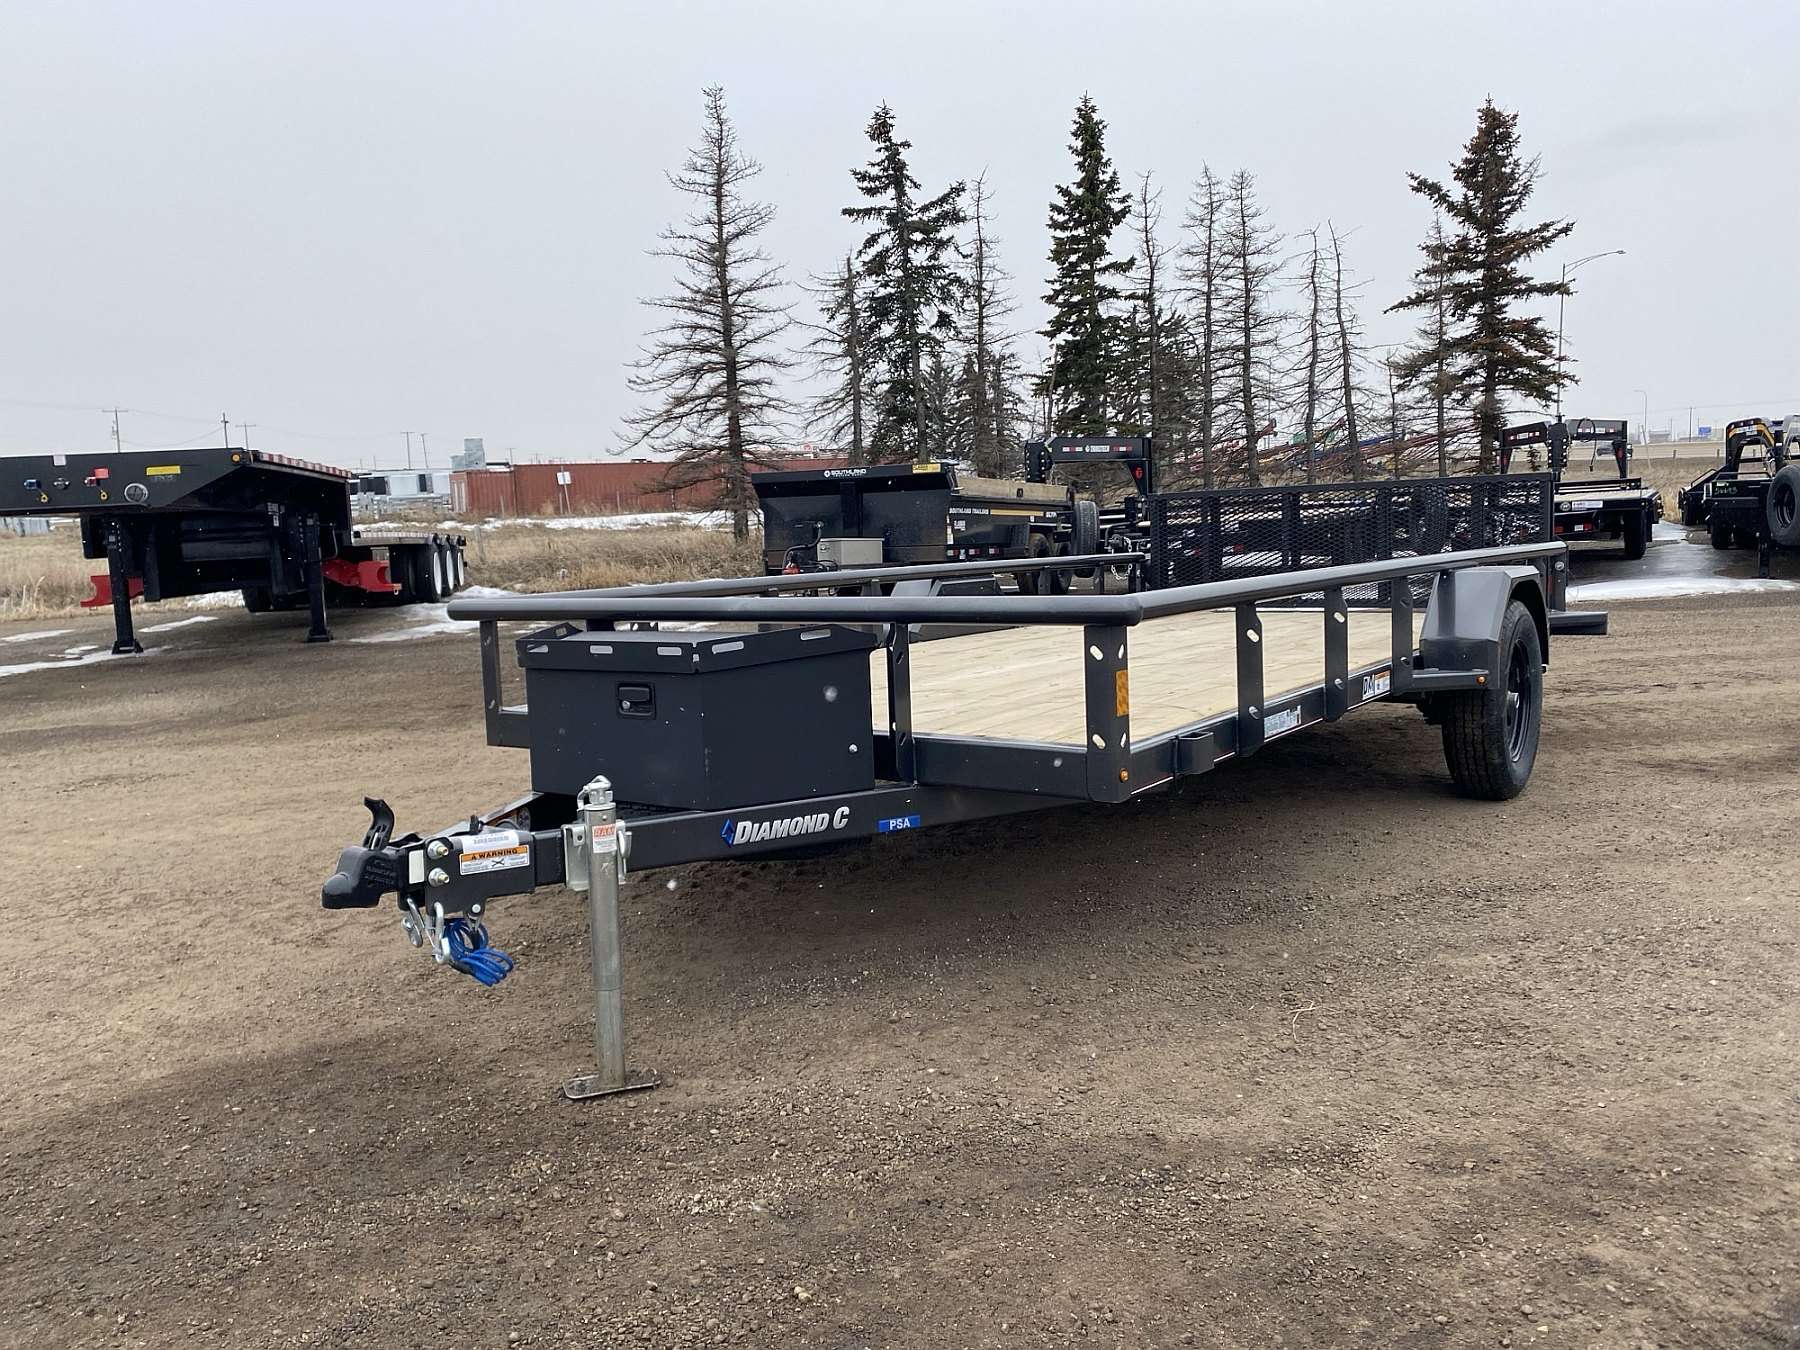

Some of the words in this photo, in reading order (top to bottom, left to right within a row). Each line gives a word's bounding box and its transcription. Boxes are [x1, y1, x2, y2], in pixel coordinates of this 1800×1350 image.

[733, 812, 830, 845] DIAMOND
[833, 806, 850, 830] C
[889, 818, 911, 830] PSA
[479, 848, 518, 859] WARNING
